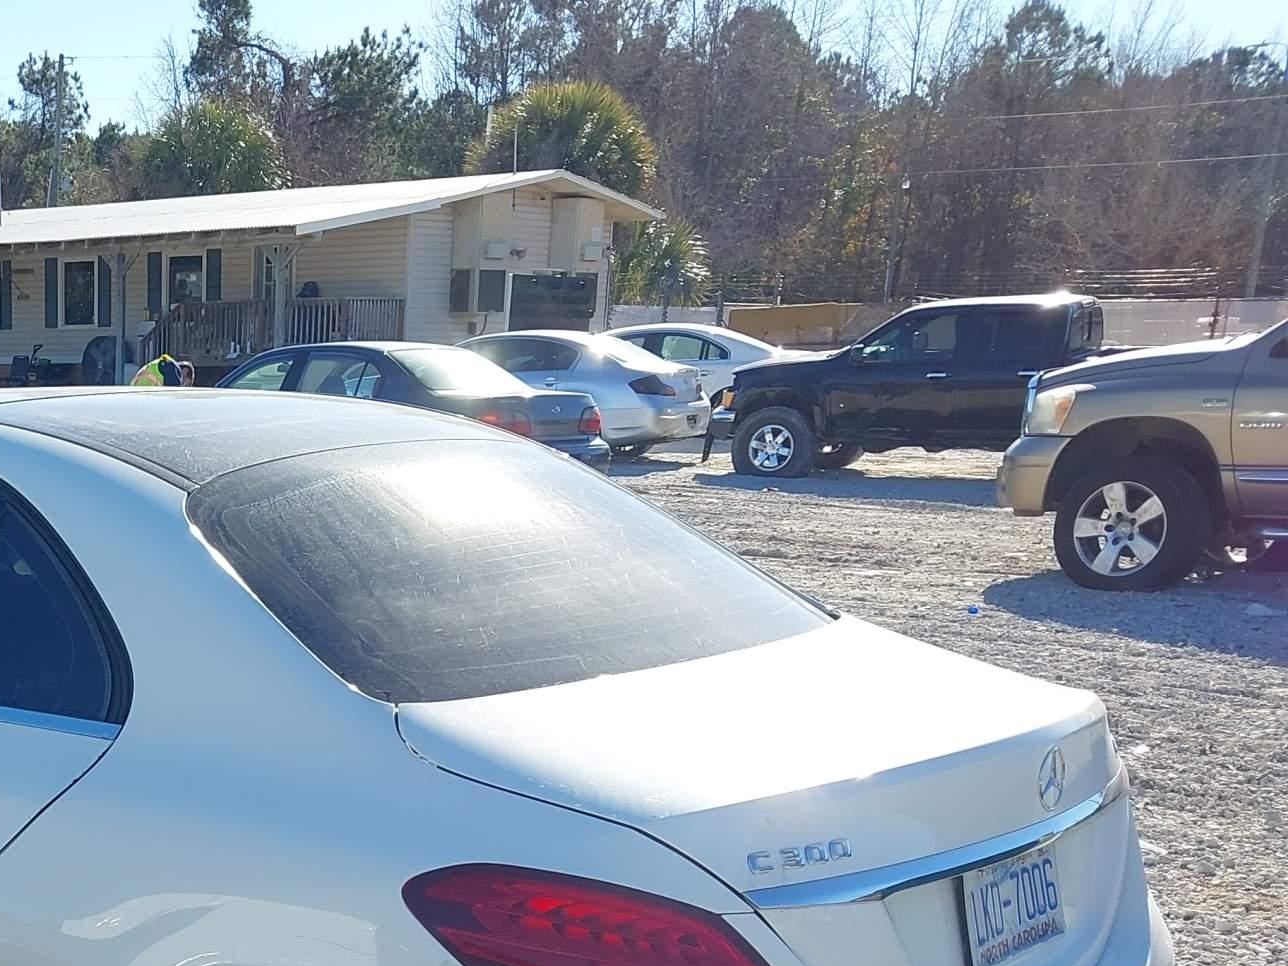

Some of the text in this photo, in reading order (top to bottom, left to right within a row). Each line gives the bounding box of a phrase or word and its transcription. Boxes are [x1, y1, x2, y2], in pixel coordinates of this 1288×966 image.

[747, 838, 851, 874] C 300
[980, 917, 1058, 964] NORTH CAROLINA
